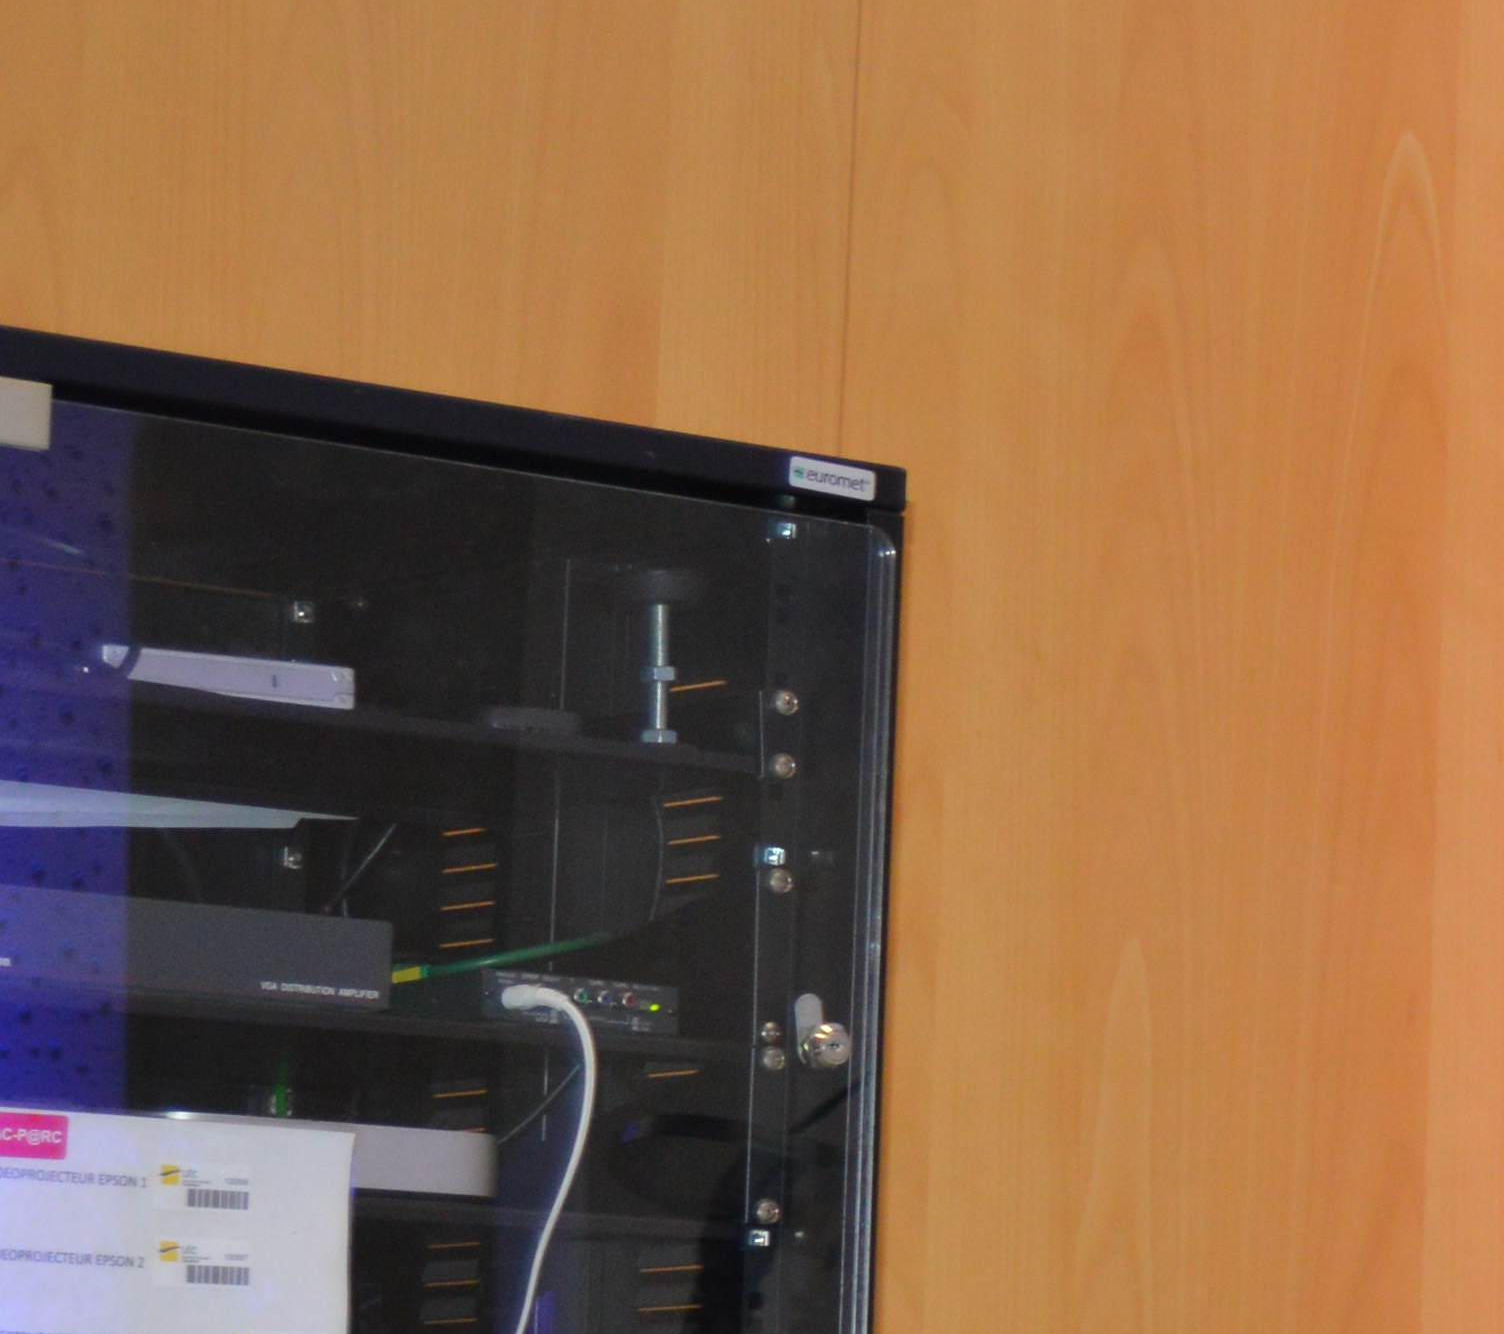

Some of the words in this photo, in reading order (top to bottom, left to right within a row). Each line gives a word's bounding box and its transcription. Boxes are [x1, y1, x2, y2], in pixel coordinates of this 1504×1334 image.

[806, 468, 865, 492] euromet
[98, 1173, 137, 1187] EPSON
[141, 1177, 147, 1188] 1
[0, 1248, 92, 1265] EOPROJECTEUR
[96, 1254, 135, 1268] EPSON
[137, 1257, 144, 1268] 2
